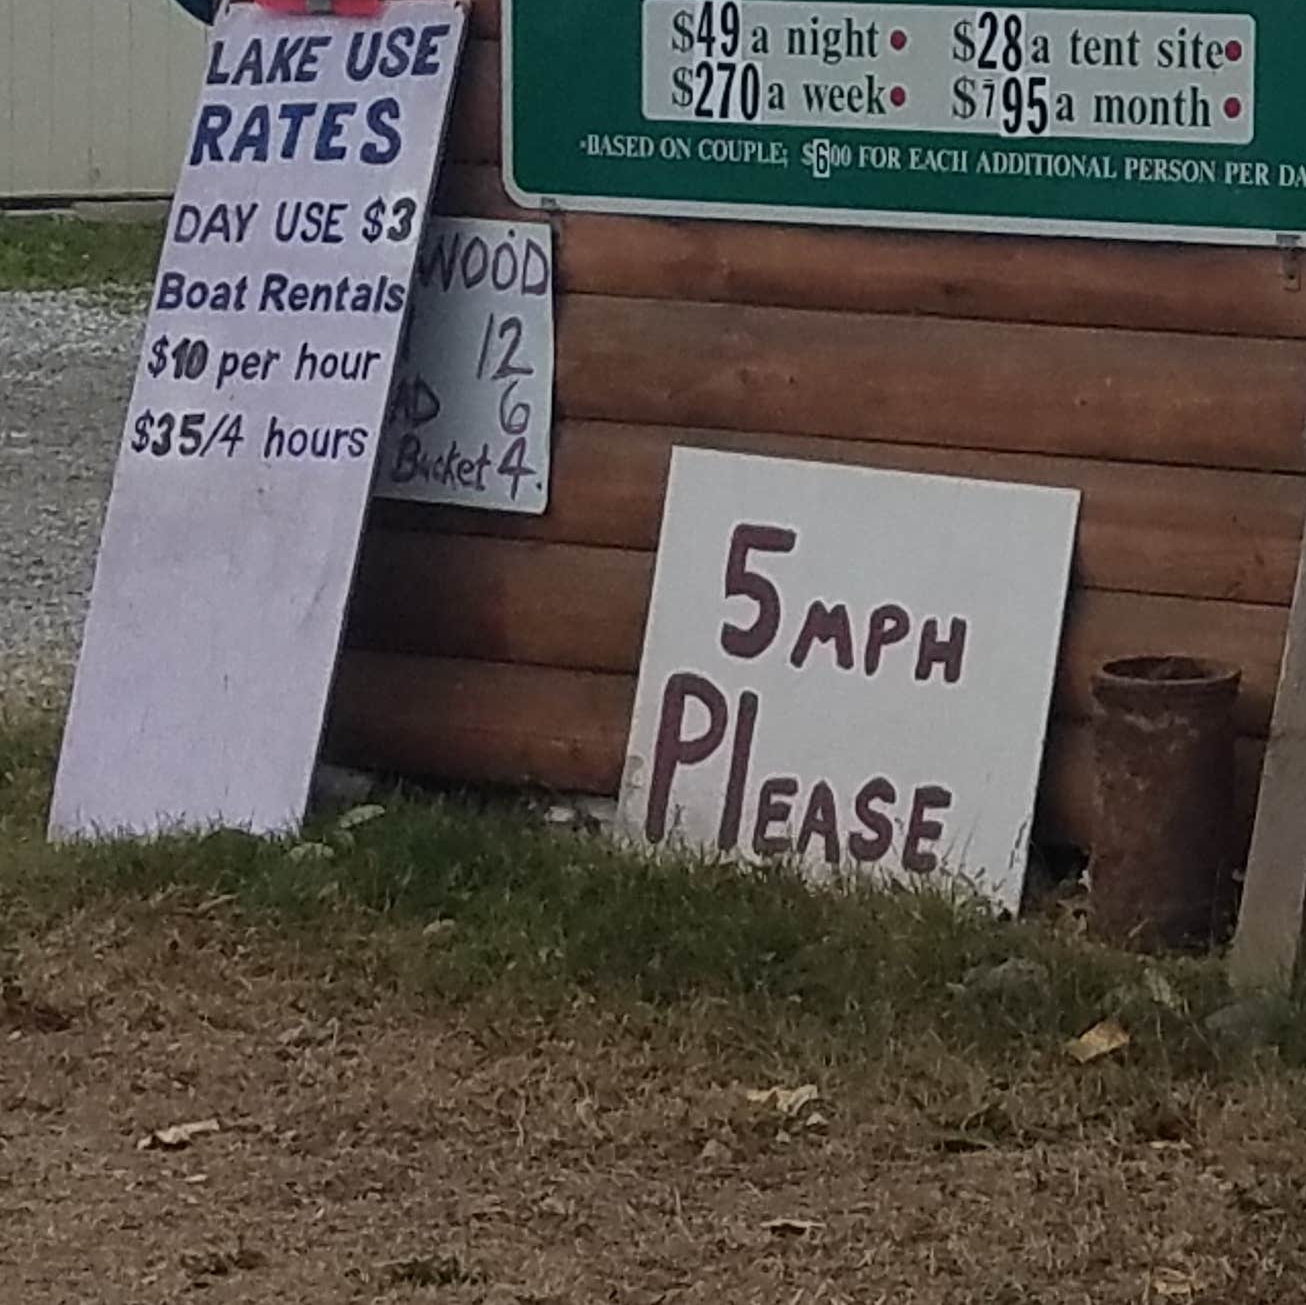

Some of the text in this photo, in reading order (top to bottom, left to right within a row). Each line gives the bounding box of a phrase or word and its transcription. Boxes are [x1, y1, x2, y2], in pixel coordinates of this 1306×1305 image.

[206, 24, 450, 86] LAKE USE
[671, 1, 879, 65] $49 a night
[952, 11, 1224, 71] $28 a tent site
[671, 61, 887, 121] $270 a week
[1056, 93, 1075, 122] a
[1093, 86, 1211, 127] month
[189, 97, 402, 166] RATES
[660, 137, 691, 159] ON
[859, 146, 901, 169] FOR
[909, 147, 968, 172] EACH
[976, 151, 1117, 179] ADDITIONAL
[1124, 157, 1216, 183] PERSON
[1225, 162, 1270, 186] PER
[174, 197, 417, 244] DAY USE $3
[156, 272, 405, 314] Boat Rentals
[147, 335, 381, 389] $10 per hour
[476, 312, 534, 380] 12
[500, 380, 531, 435] 6
[264, 417, 369, 458] hours
[391, 433, 536, 501] Bucket 4
